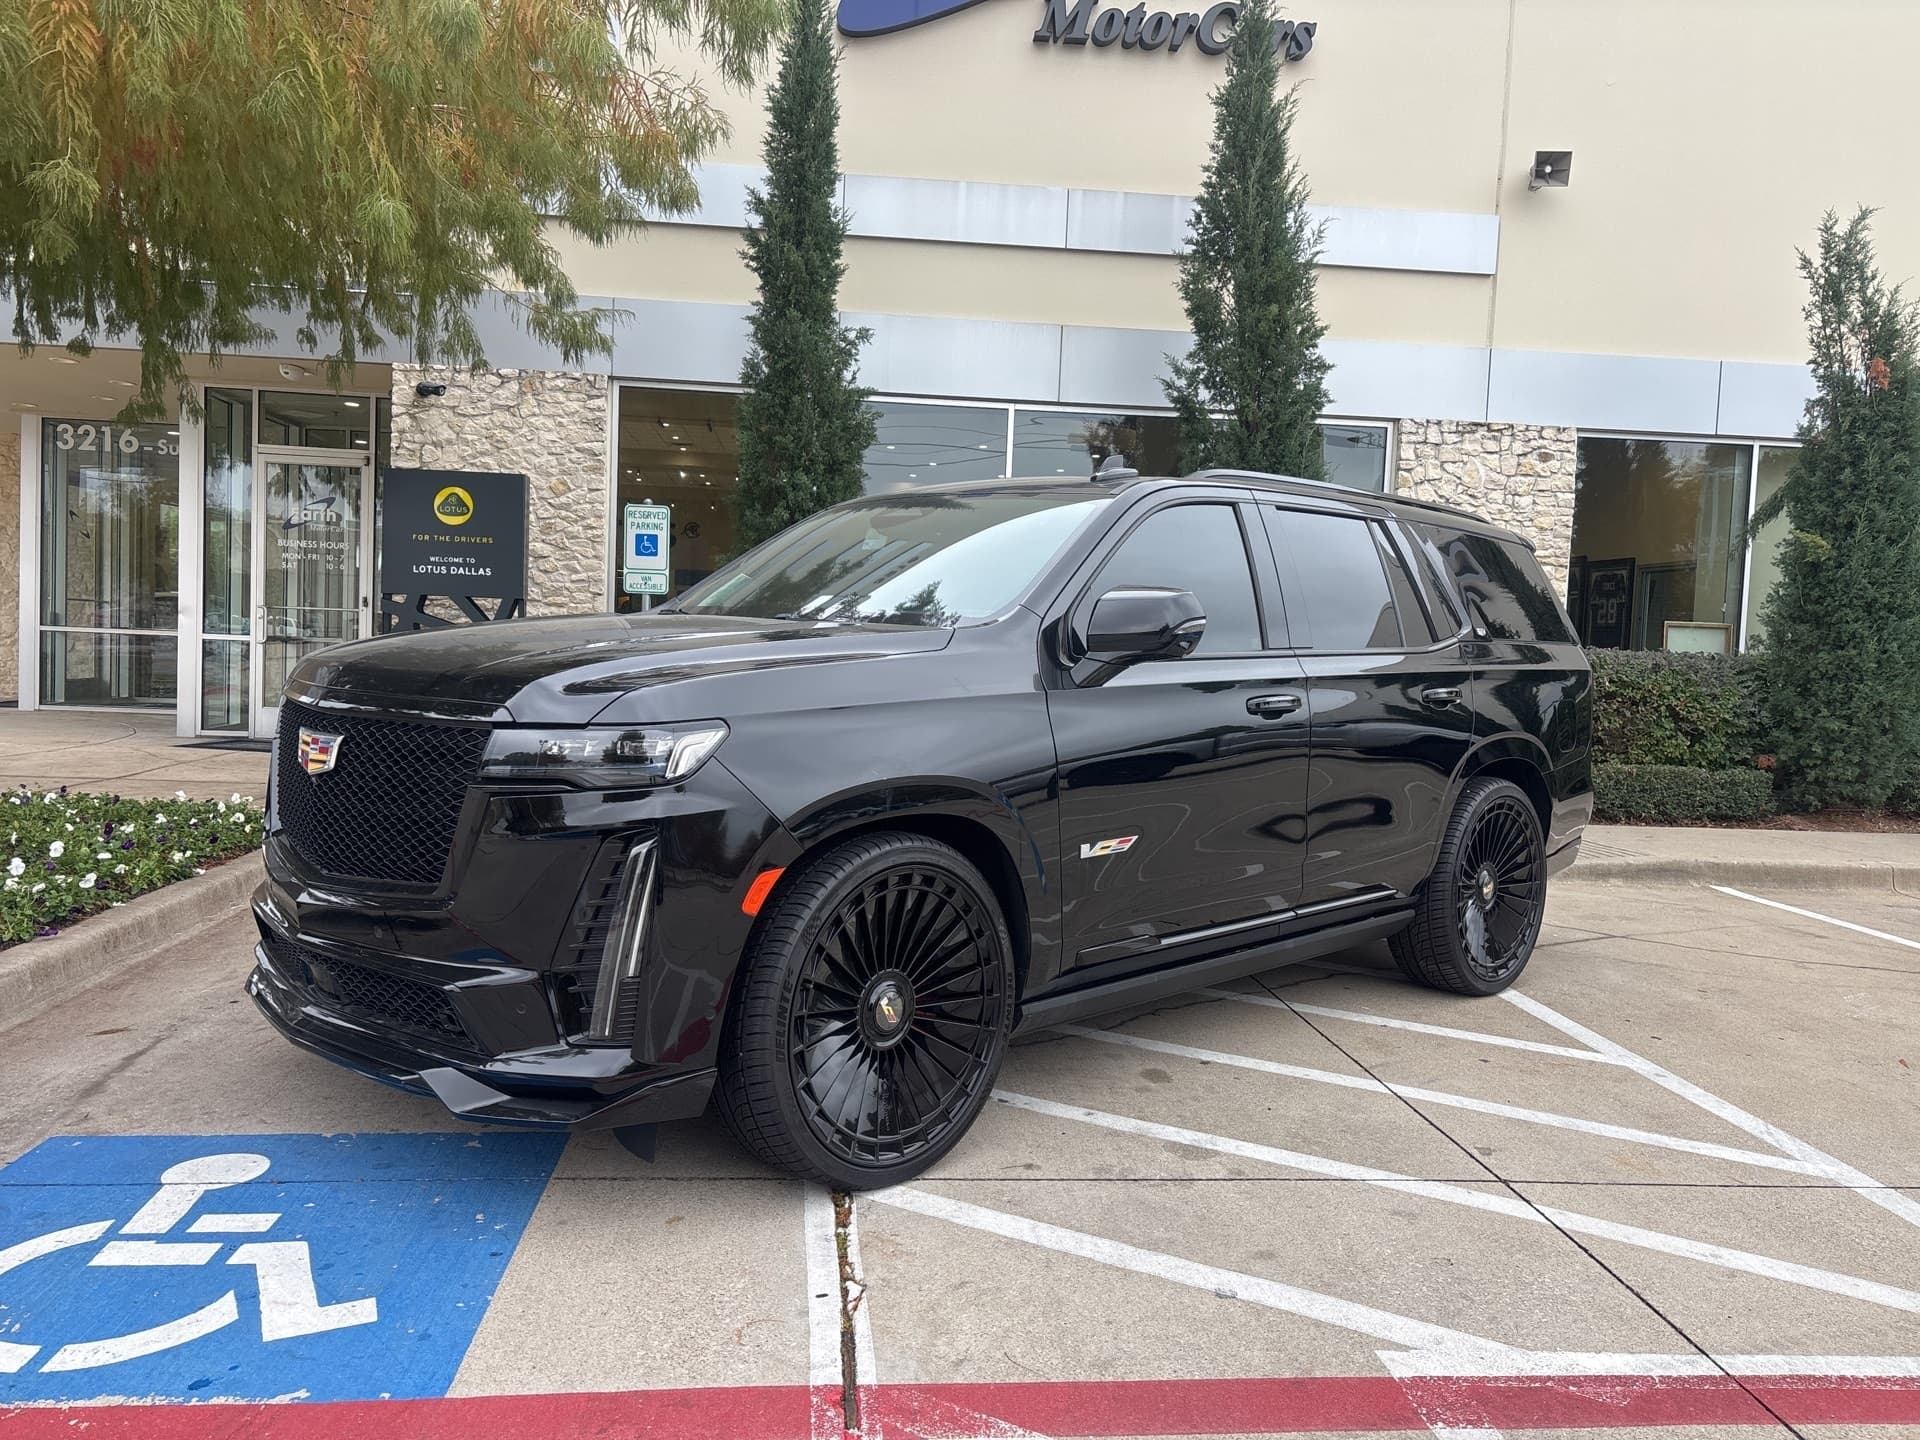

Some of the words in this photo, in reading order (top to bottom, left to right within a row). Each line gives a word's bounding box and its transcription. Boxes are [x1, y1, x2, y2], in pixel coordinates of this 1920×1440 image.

[1033, 0, 1317, 61] MotorCrs
[56, 423, 140, 454] 3216
[629, 510, 666, 520] RESERVED
[631, 522, 663, 531] PARKING
[412, 533, 430, 542] FOR
[433, 534, 451, 542] THE
[454, 535, 494, 544] DRIVERS
[277, 539, 317, 548] BUSINESS
[319, 541, 350, 550] HOURS
[282, 552, 302, 560] MON
[307, 553, 320, 561] FRI
[429, 556, 463, 564] WELCOME
[281, 561, 297, 569] SAT
[412, 564, 447, 574] LOTUS
[450, 566, 492, 576] DALLAS
[629, 582, 663, 590] ACCESSIBLE
